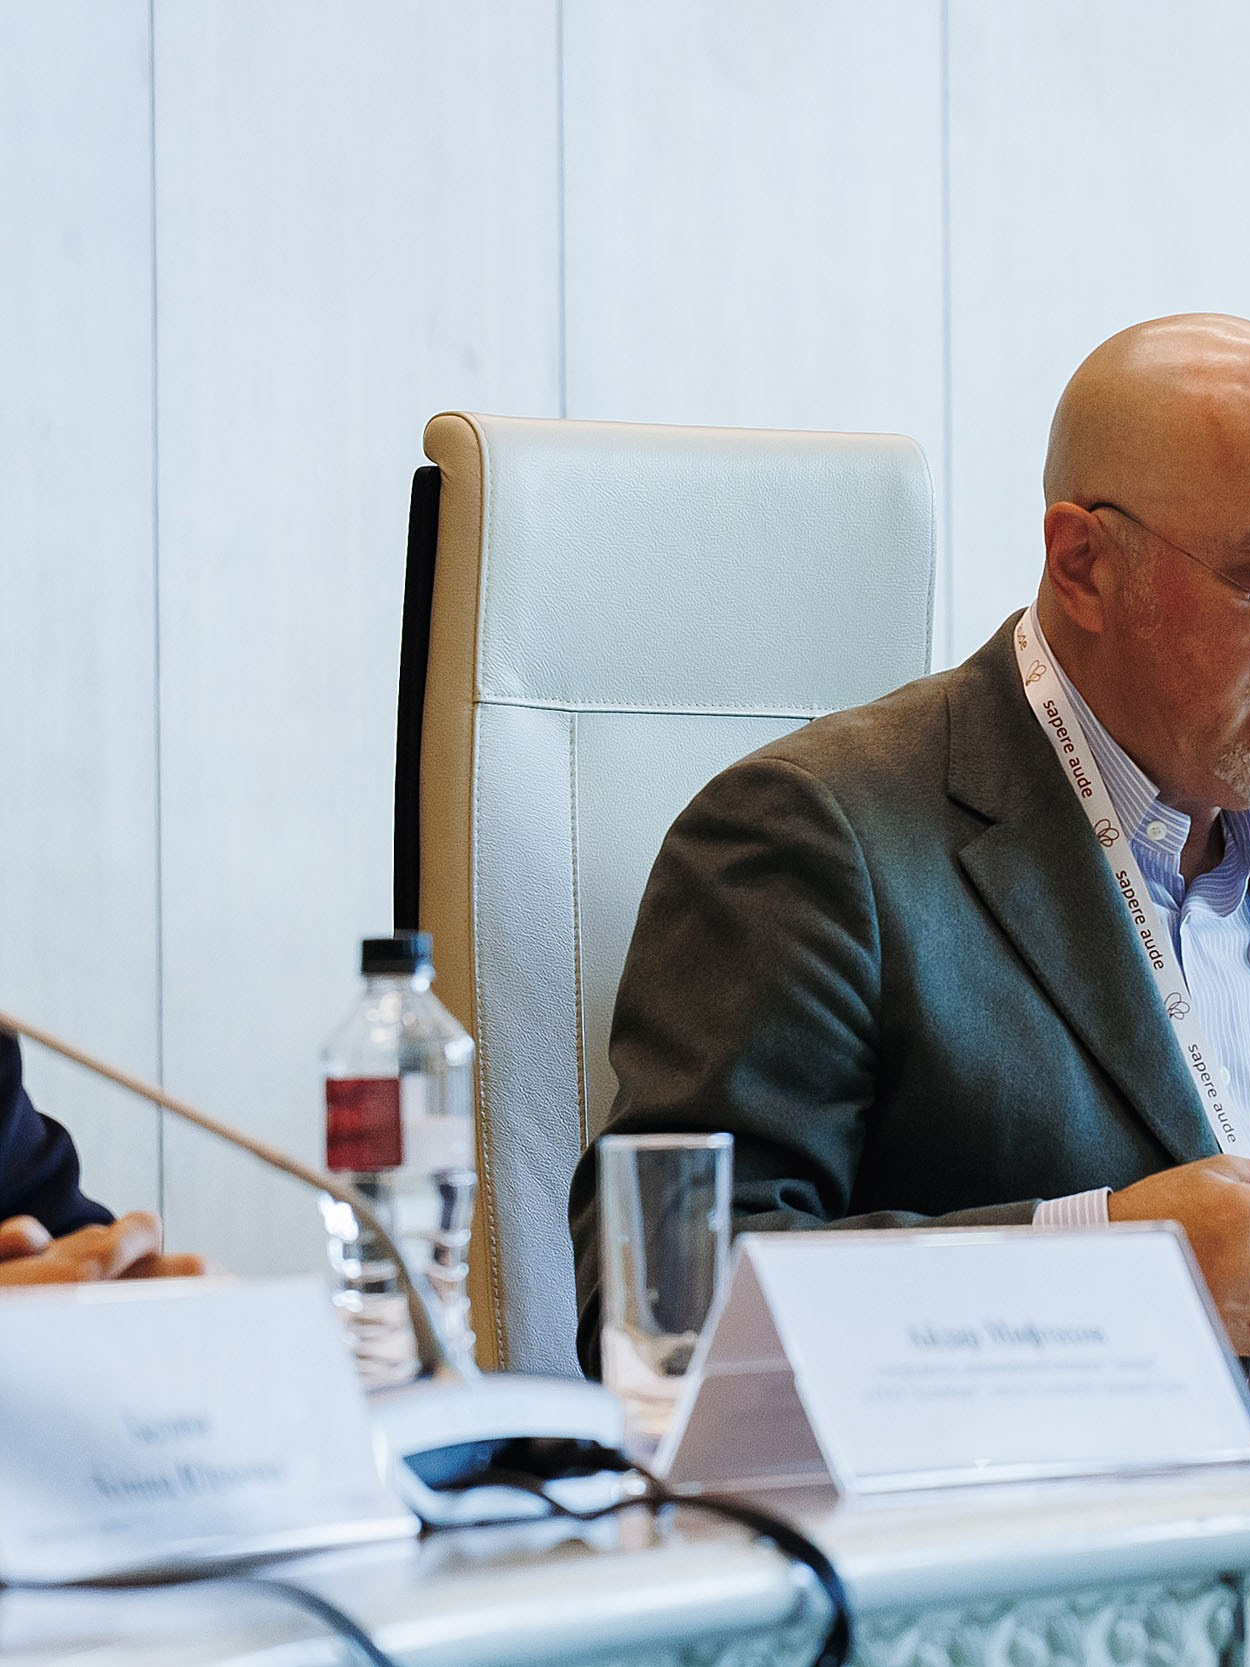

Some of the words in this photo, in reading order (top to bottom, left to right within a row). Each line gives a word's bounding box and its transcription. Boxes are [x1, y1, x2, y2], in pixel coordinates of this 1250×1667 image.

[1043, 699, 1075, 754] sapere
[1069, 757, 1093, 799] aude
[1115, 870, 1146, 926] sapere
[1140, 929, 1165, 970] aude
[1188, 1043, 1218, 1099] sapere
[1213, 1102, 1236, 1145] aude
